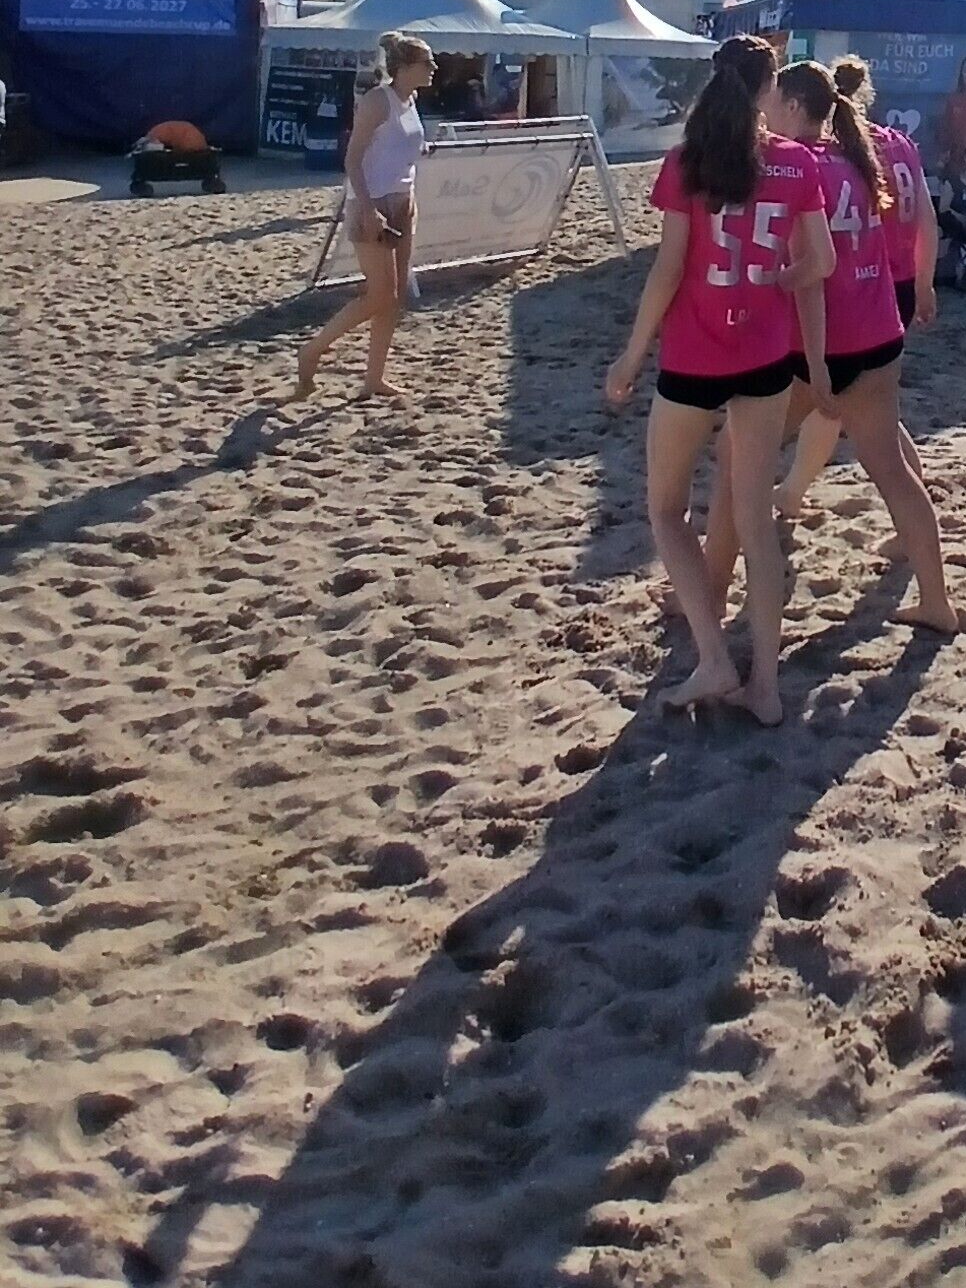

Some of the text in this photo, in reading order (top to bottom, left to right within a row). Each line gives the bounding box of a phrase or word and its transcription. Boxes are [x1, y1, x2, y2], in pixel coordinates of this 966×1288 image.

[885, 40, 954, 58] FÜR EUCH
[869, 58, 929, 74] DA SIND
[706, 201, 789, 286] 55
